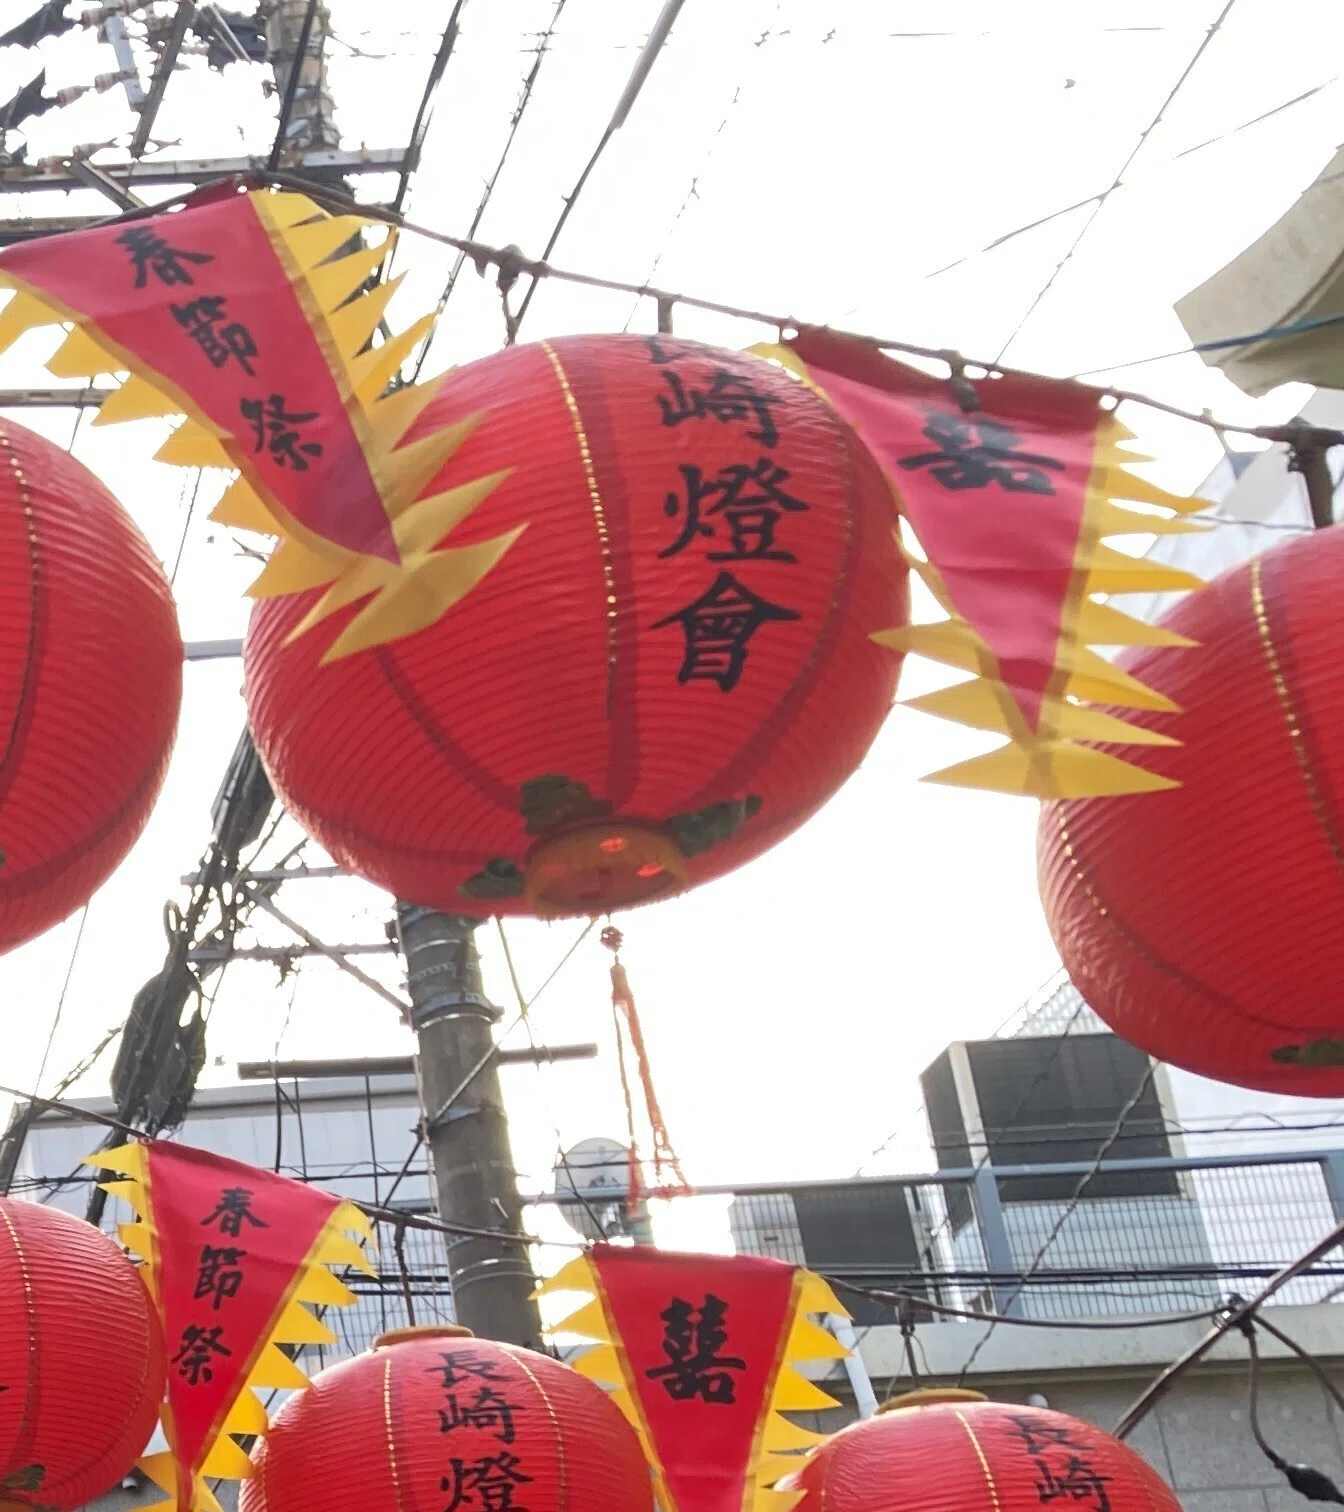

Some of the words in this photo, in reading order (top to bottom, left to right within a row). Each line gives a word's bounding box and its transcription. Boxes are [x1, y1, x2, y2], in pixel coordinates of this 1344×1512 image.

[115, 224, 324, 472] 春節祭
[171, 1186, 269, 1386] 春節祭
[646, 1293, 746, 1405] 囍
